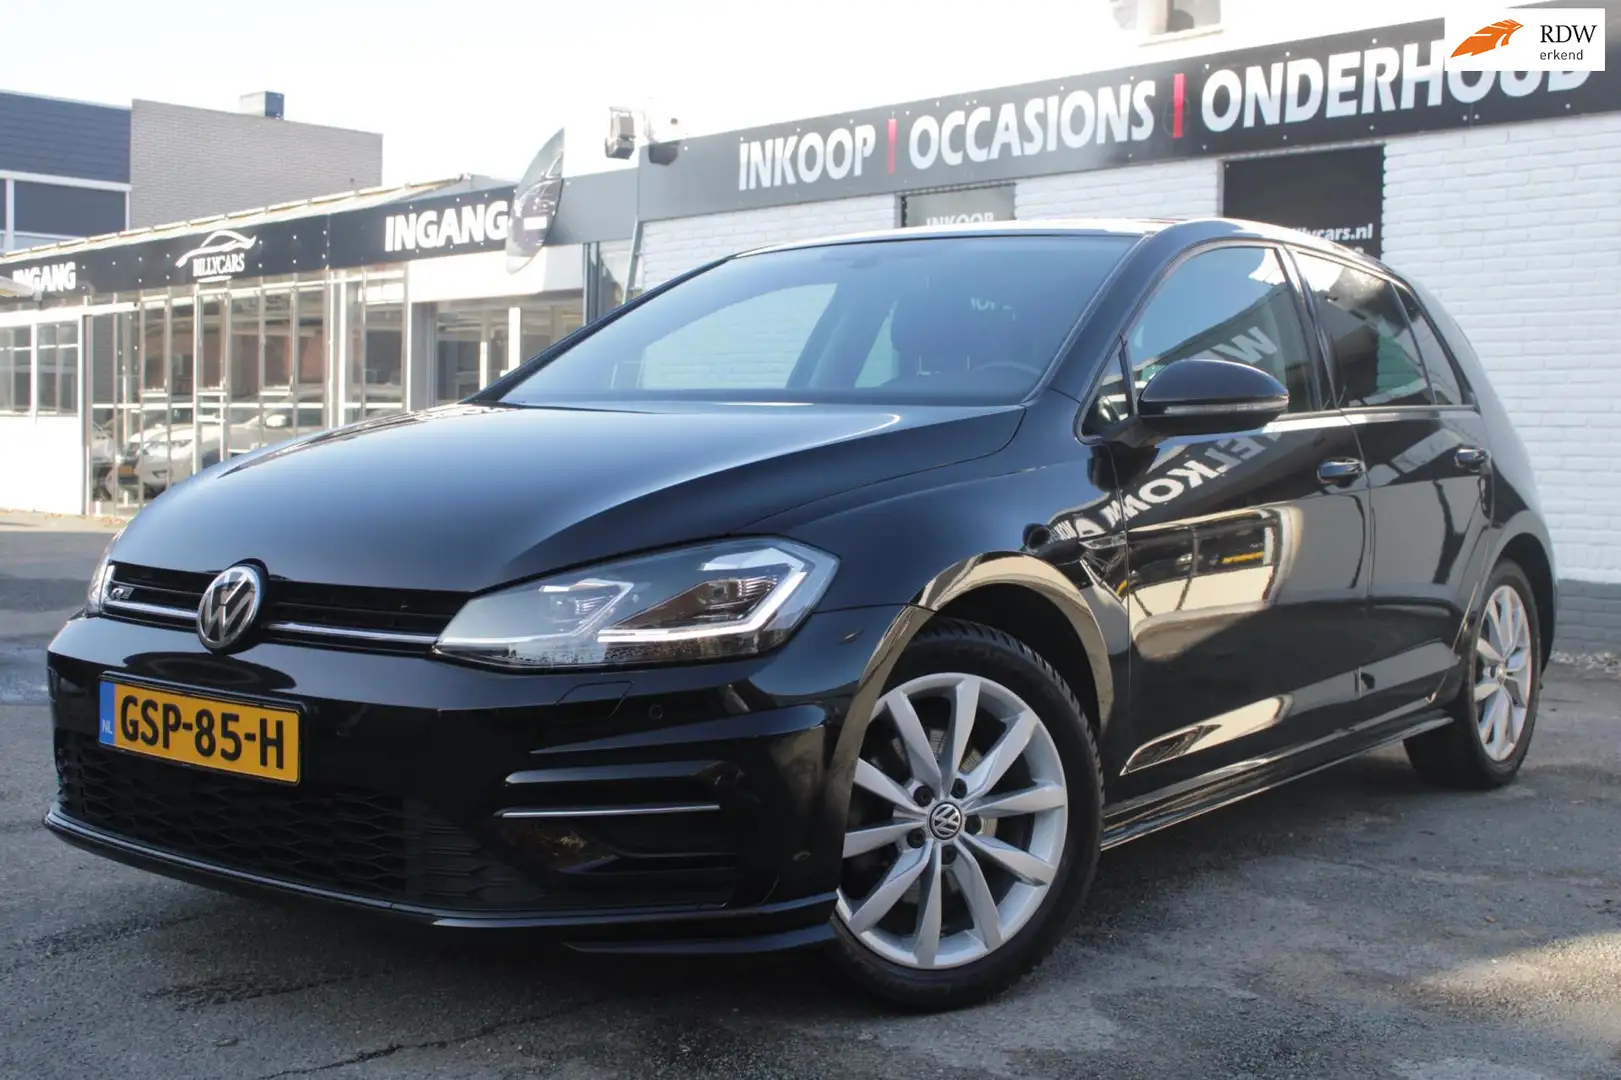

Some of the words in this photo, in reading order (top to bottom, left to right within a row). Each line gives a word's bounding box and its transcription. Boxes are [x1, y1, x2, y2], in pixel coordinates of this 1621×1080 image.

[738, 124, 876, 191] INKOOP
[908, 80, 1156, 170] OCCASIONS
[384, 200, 508, 252] INGANG
[101, 719, 113, 735] NL
[120, 695, 284, 770] GSP-85-H
